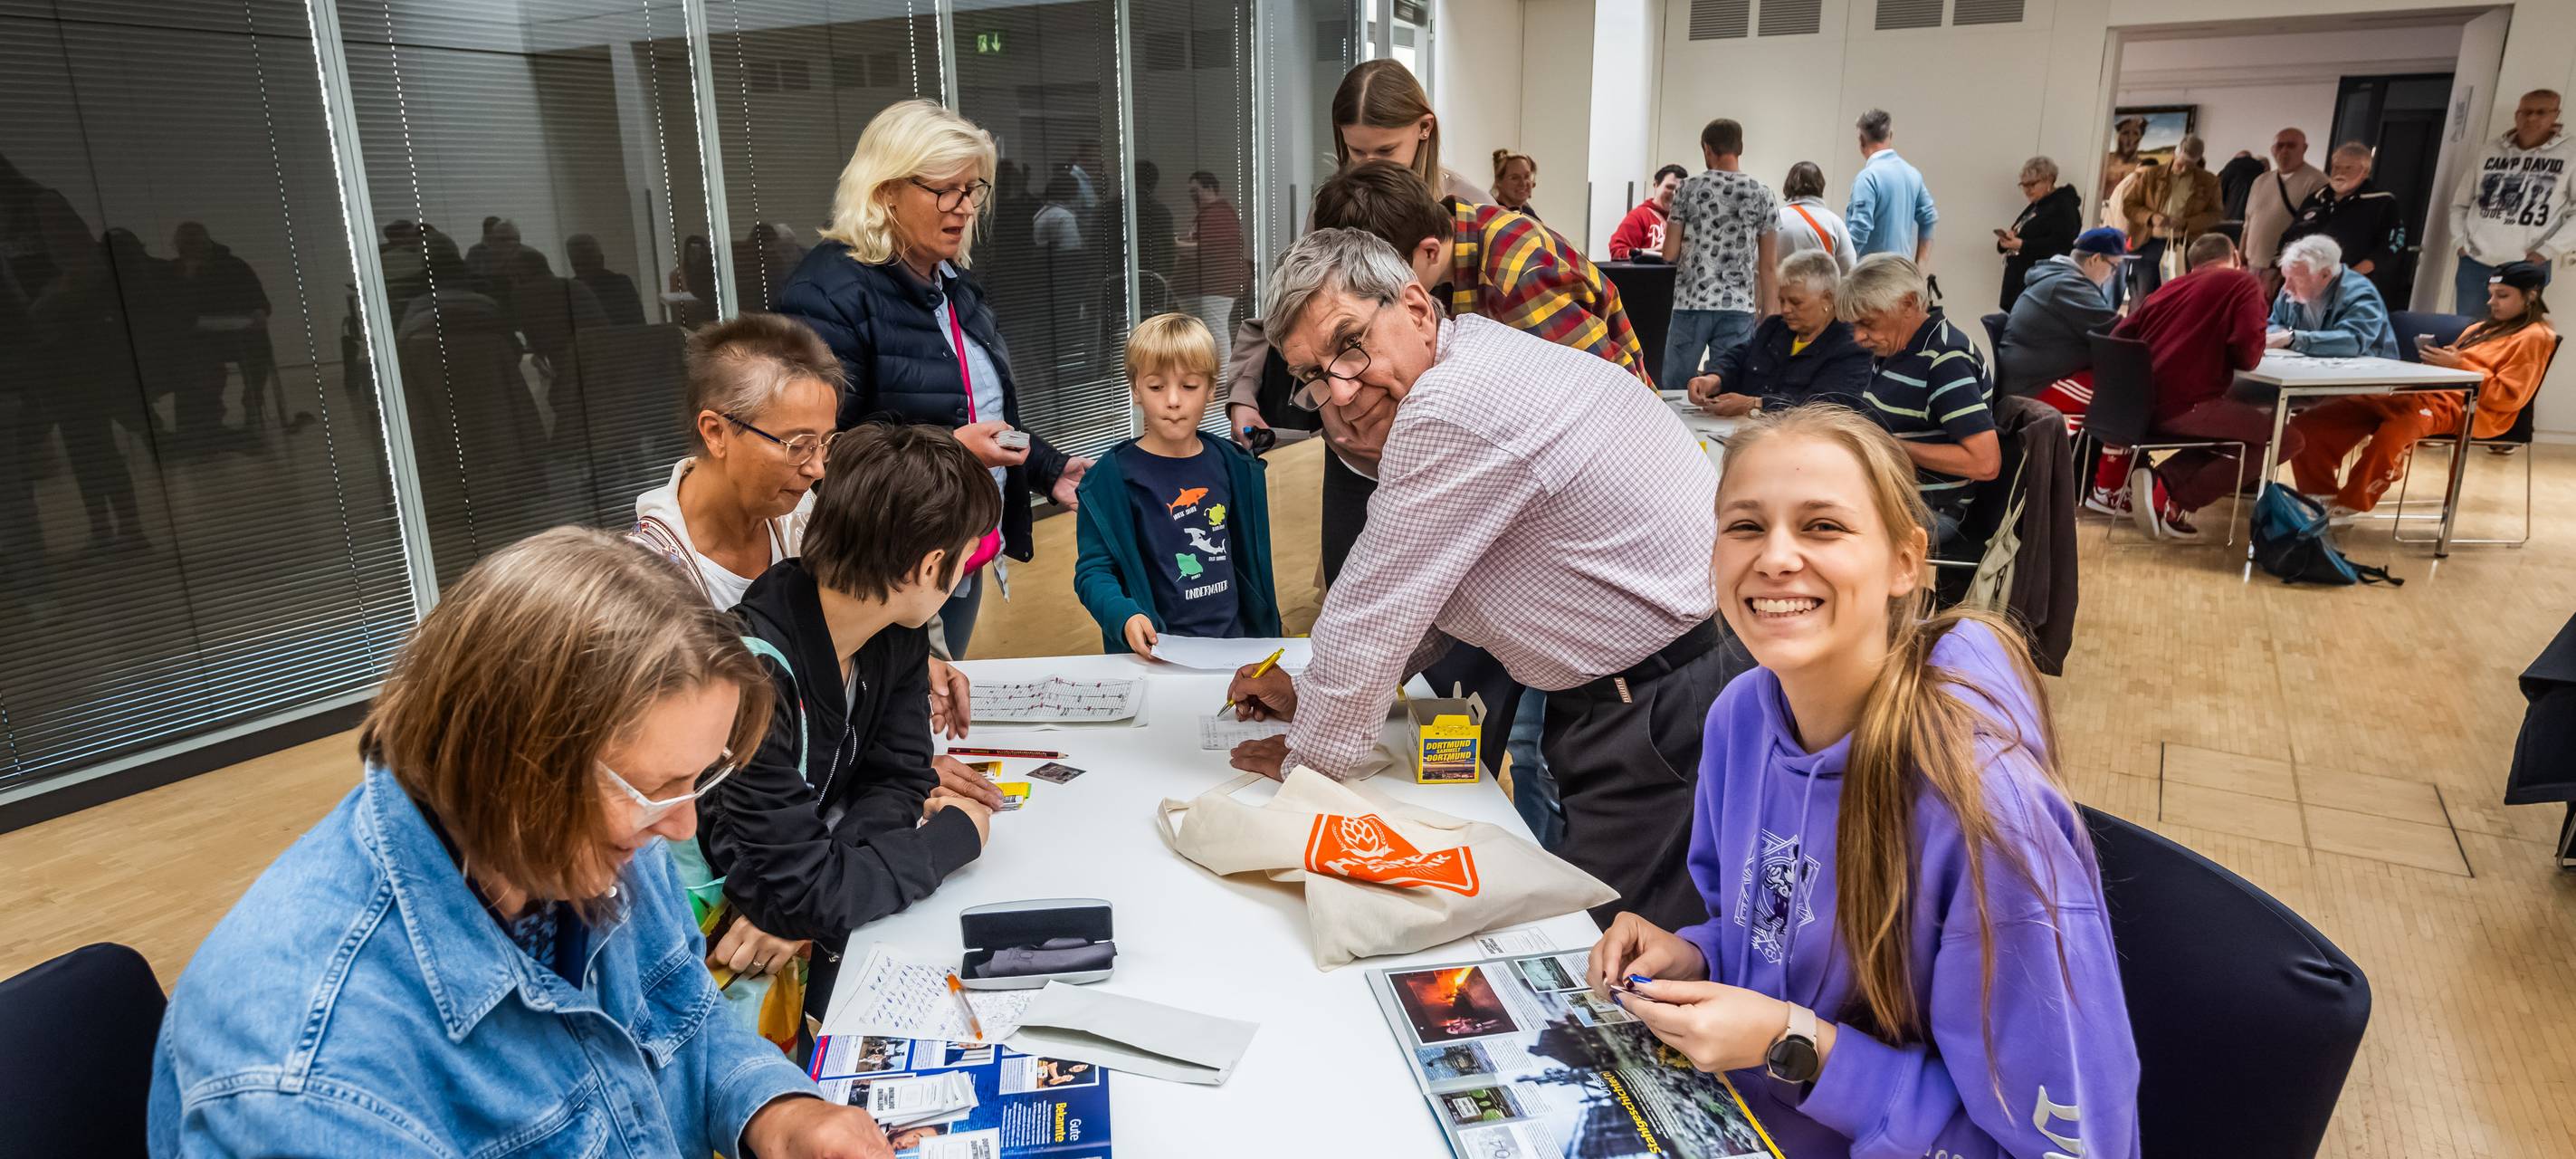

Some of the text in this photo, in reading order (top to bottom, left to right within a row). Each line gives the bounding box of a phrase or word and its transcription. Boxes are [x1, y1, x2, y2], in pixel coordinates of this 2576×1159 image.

[2483, 157, 2564, 174] CAMP DAVID
[2518, 200, 2550, 226] 63
[1426, 739, 1472, 751] DORTMUND
[1426, 751, 1472, 761] DORTMUND
[1054, 1102, 1068, 1143] Bekannte
[1069, 1118, 1082, 1141] Gute
